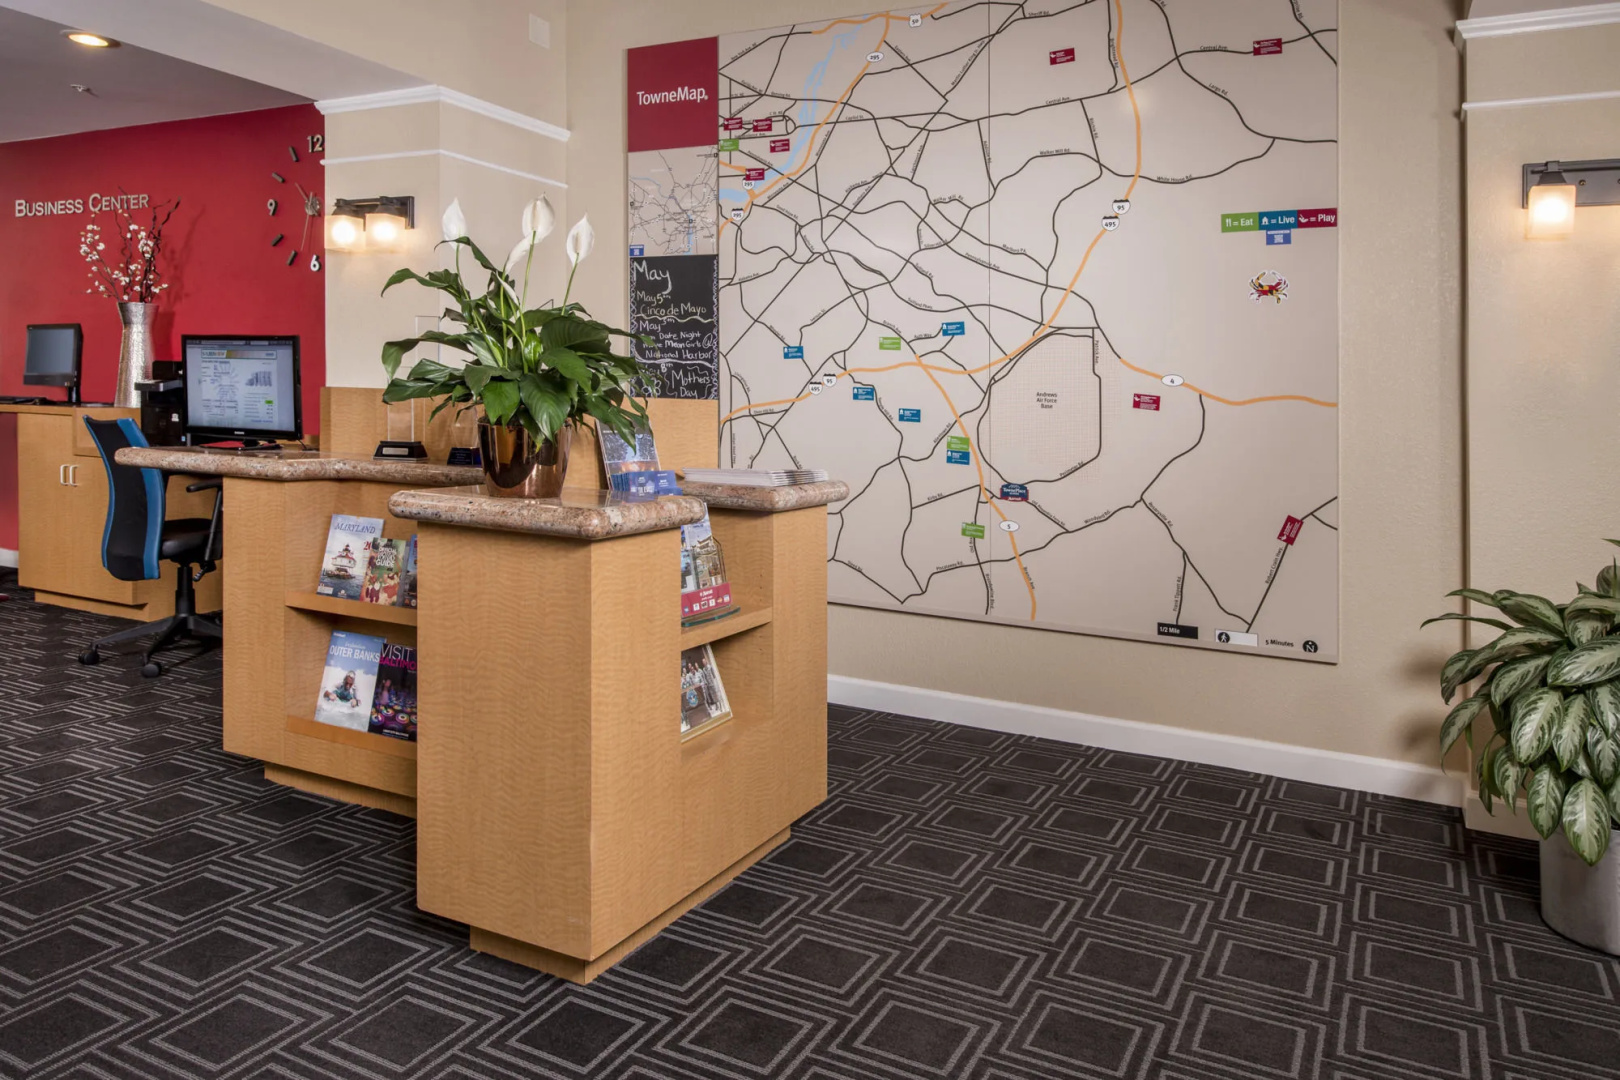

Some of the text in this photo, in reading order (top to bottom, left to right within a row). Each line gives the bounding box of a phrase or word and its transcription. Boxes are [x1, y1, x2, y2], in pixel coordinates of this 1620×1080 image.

[1208, 82, 1221, 92] Largo
[307, 134, 323, 152] 12
[267, 199, 276, 216] 9
[1278, 216, 1295, 224] Live
[1318, 214, 1336, 222] Play
[310, 254, 320, 272] 6
[634, 260, 672, 294] May
[637, 290, 656, 306] May
[640, 302, 706, 316] Cinco de Mayo
[640, 320, 661, 332] May
[680, 332, 700, 340] Night
[665, 340, 684, 348] Mean
[682, 350, 712, 359] Harbor
[672, 369, 710, 388] Mothers
[680, 387, 698, 399] Day
[1060, 464, 1078, 477] Perimeter
[1084, 514, 1104, 524] Woodyard
[334, 522, 376, 534] MARYLAND
[376, 559, 394, 568] GUIDE
[1265, 568, 1275, 584] Robert
[1271, 556, 1280, 570] Crain
[1270, 640, 1294, 648] Minutes
[330, 646, 352, 658] OUTER
[354, 650, 380, 662] BANKS
[382, 643, 414, 662] VISIT
